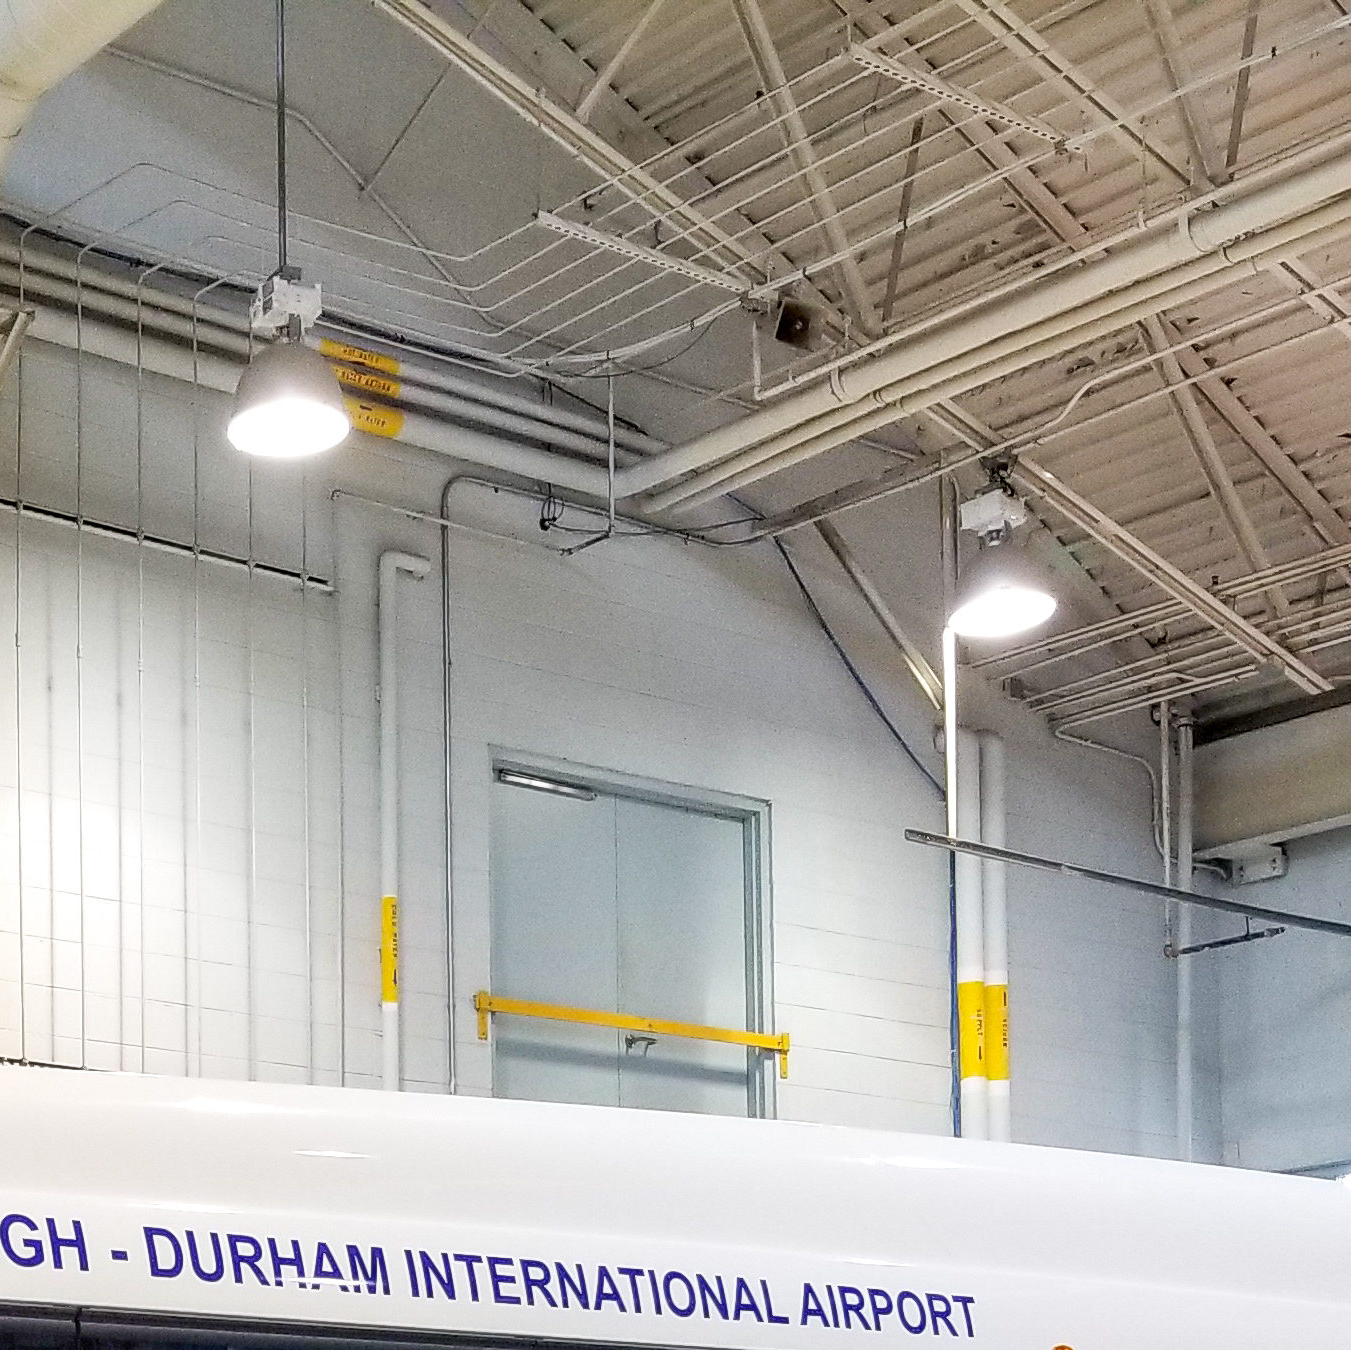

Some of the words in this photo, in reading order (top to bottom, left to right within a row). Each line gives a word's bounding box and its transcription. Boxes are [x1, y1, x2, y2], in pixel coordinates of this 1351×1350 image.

[144, 1227, 390, 1296] DURHAM
[405, 1250, 790, 1325] INTERNATIONAL
[801, 1283, 974, 1338] AIRPORT
